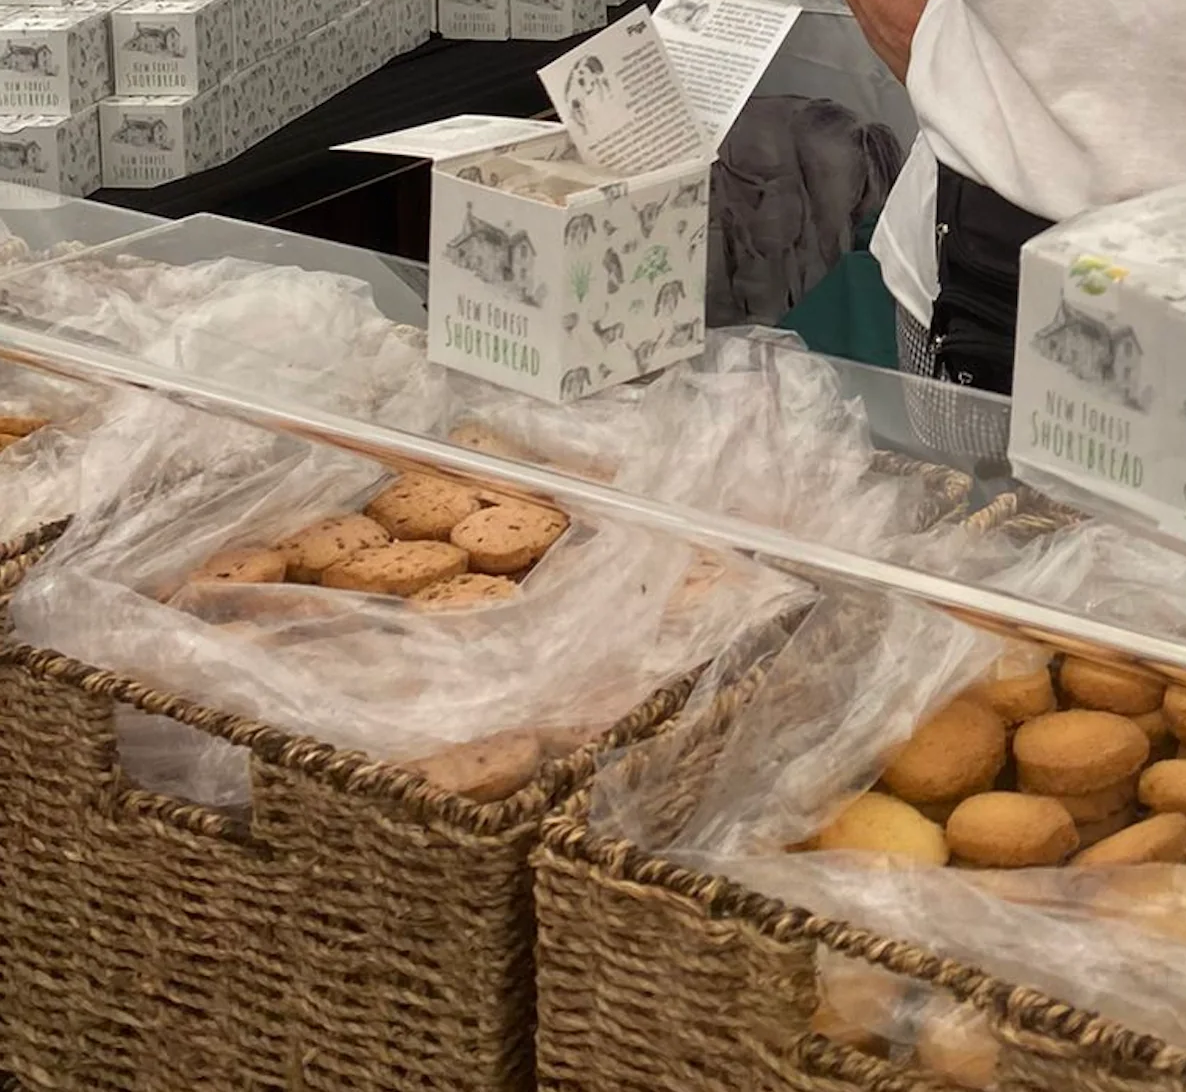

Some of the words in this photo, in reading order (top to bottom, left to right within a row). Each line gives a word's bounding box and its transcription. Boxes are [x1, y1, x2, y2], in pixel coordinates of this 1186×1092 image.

[445, 315, 540, 377] SHORTBREAD
[456, 294, 481, 322] NEW
[488, 303, 529, 338] FOREST
[1046, 389, 1075, 422] NEW
[1082, 402, 1131, 447] FOREST
[1031, 410, 1143, 488] SHORTBREAD
